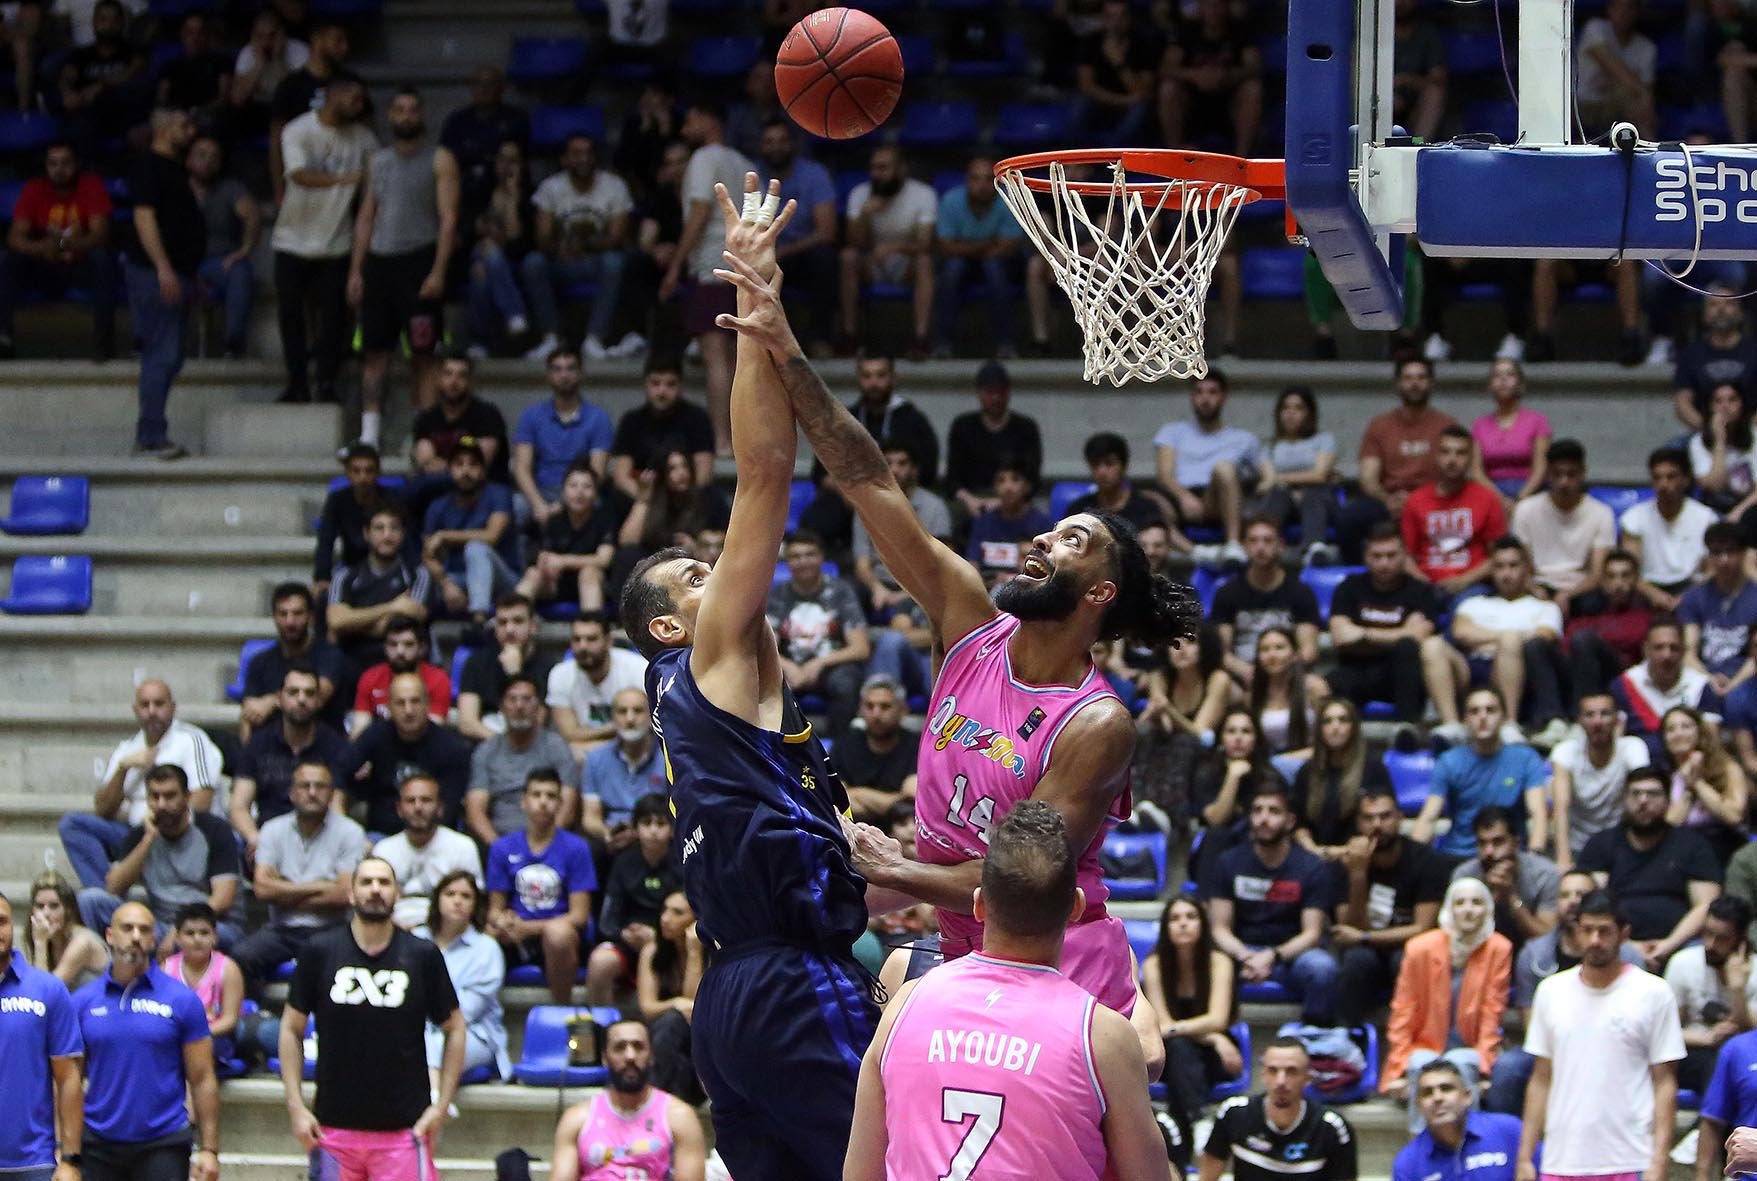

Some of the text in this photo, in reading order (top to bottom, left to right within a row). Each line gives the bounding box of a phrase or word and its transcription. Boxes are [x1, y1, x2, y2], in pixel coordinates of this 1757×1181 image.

[1655, 159, 1757, 191] Sch
[801, 774, 816, 790] 35
[928, 1029, 1041, 1075] AYOUBI
[938, 1087, 1005, 1181] 7
